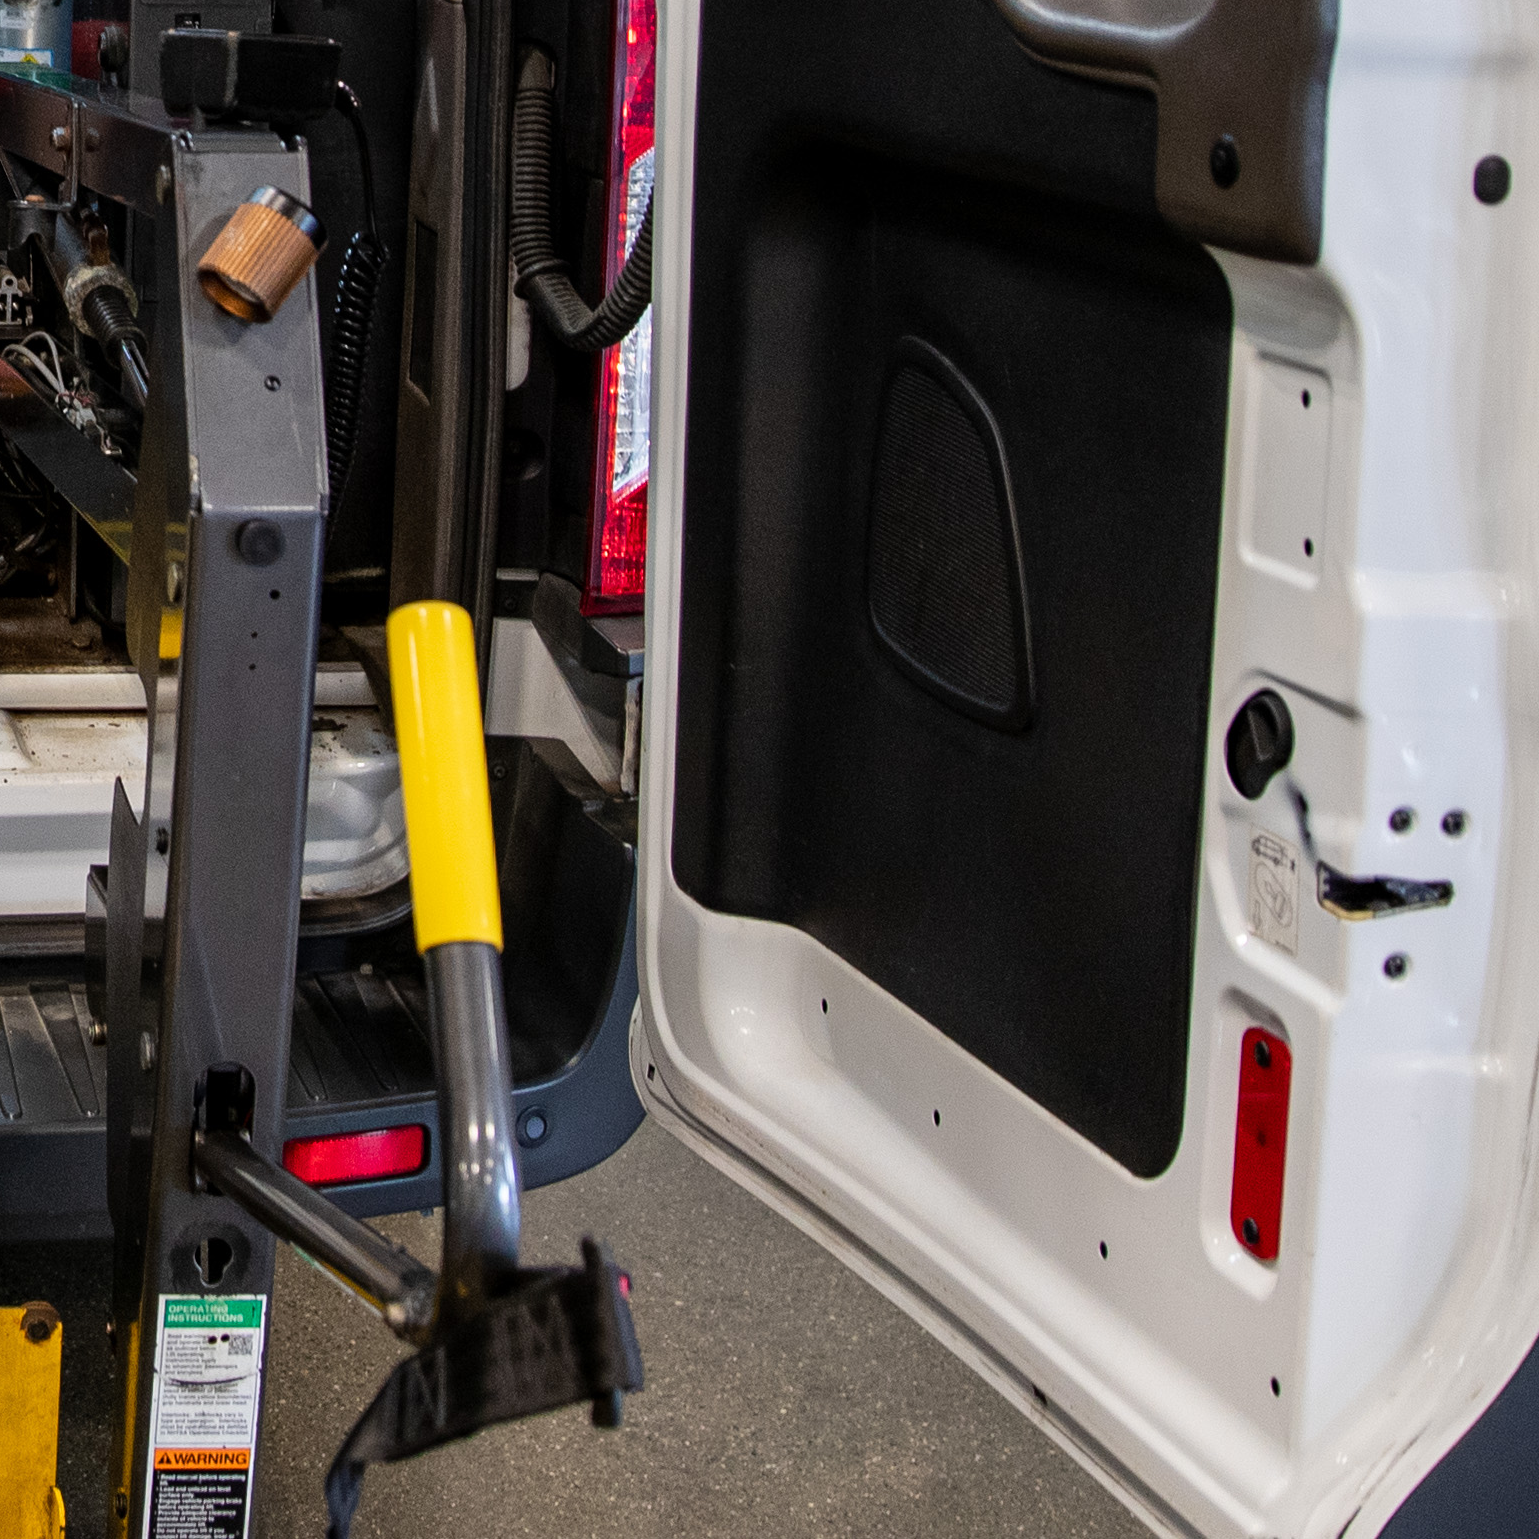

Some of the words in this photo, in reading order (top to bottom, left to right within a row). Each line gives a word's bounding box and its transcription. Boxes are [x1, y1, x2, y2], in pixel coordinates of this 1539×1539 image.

[168, 1304, 229, 1314] OPERATING
[168, 1313, 244, 1323] INSTRUCTIONS
[174, 1452, 248, 1465] WARNING
